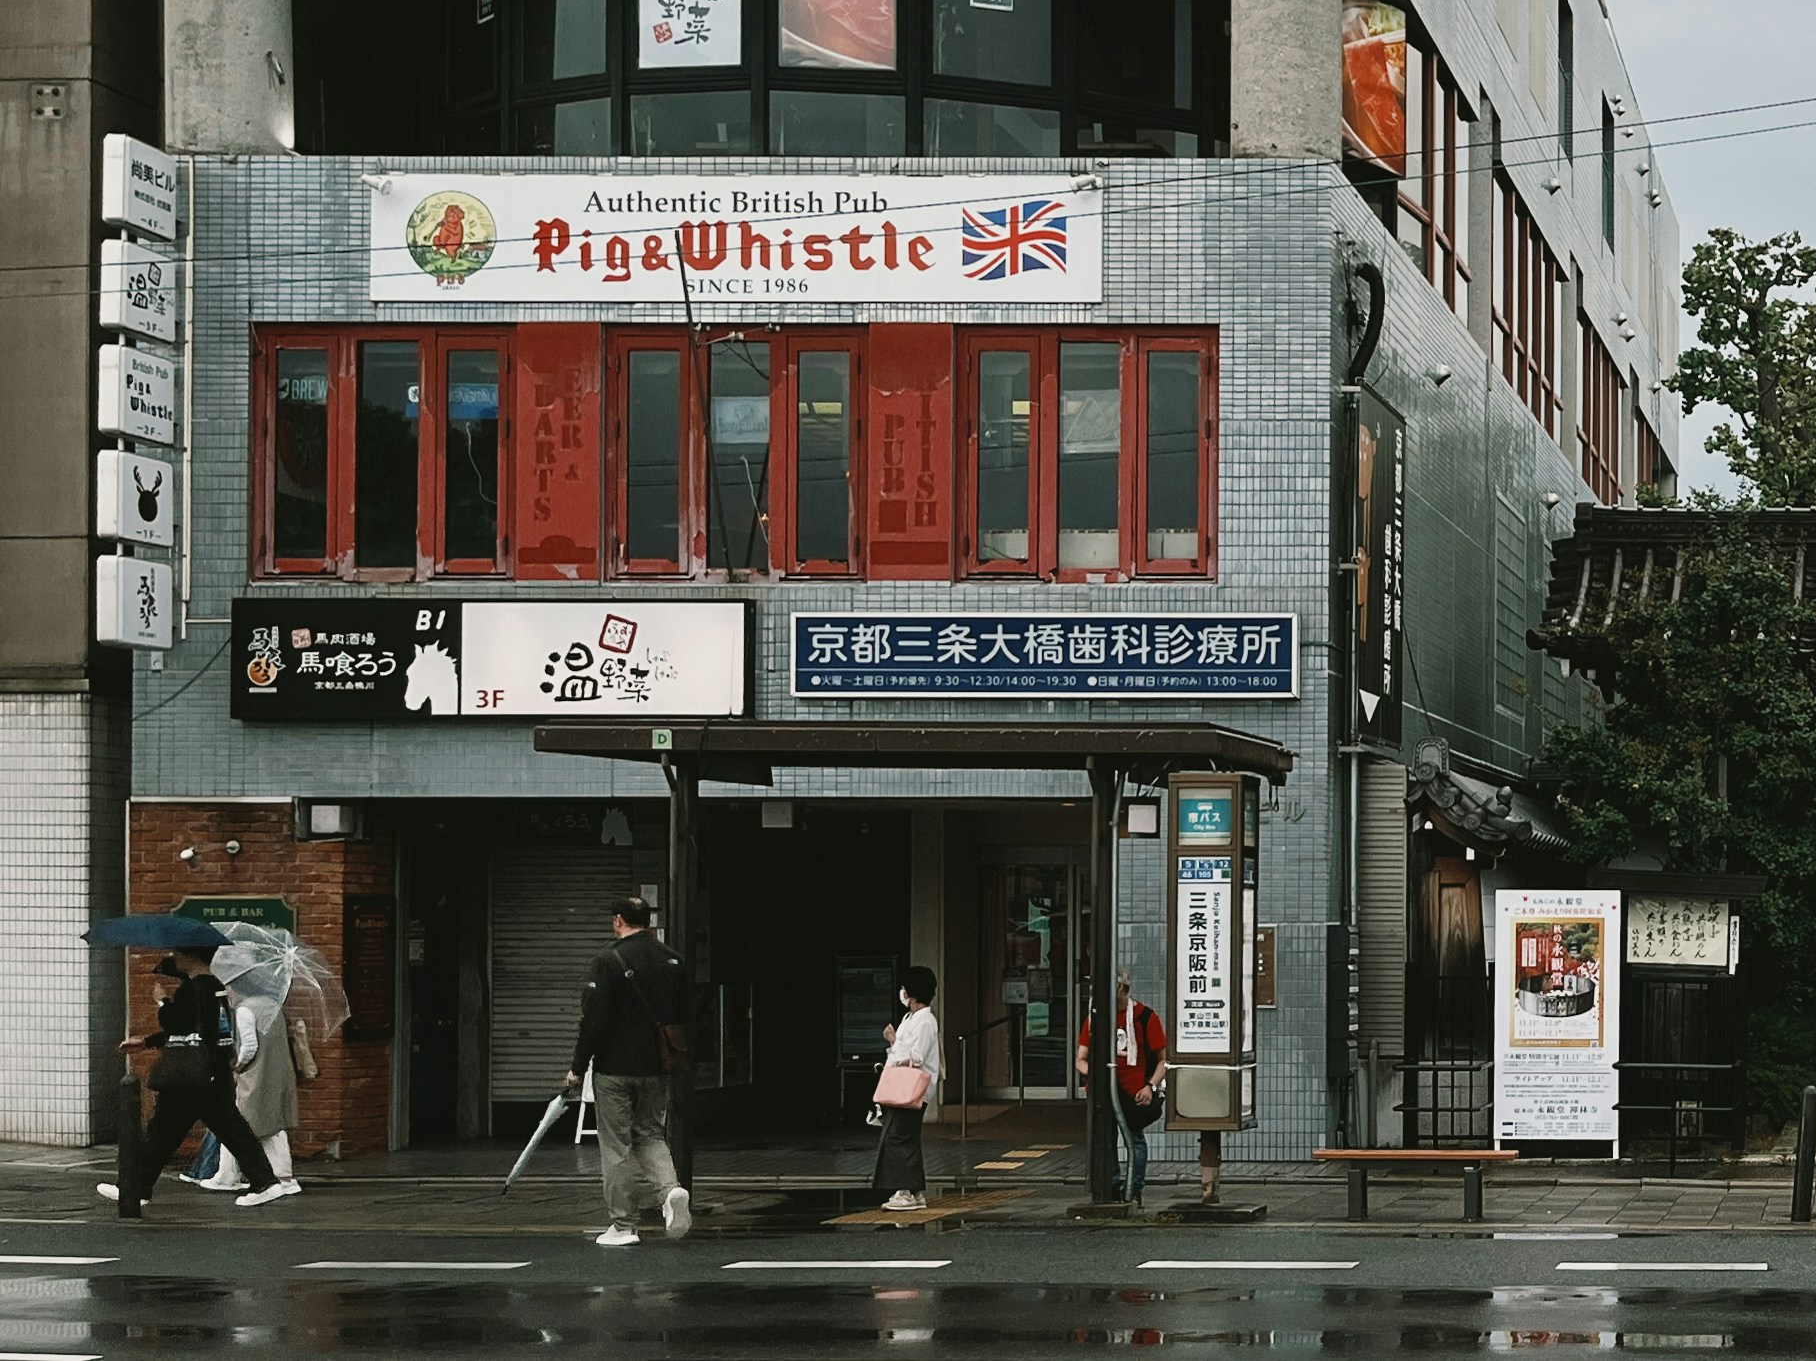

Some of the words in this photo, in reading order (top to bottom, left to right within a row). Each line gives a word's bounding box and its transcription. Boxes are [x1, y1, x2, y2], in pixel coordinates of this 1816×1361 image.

[131, 158, 175, 193] 尚美ビル
[584, 190, 721, 213] Authentic
[732, 190, 823, 214] British
[834, 190, 888, 214] Pub
[533, 217, 936, 282] Pig&Whistle
[686, 278, 753, 294] SINCE
[764, 278, 809, 294] 1986
[132, 358, 153, 376] British
[155, 364, 169, 380] Pub
[130, 396, 173, 422] Whistle
[415, 609, 446, 631] B1
[314, 632, 376, 646] 馬肉酒場
[807, 623, 1281, 665] 京都三条大橋歯科診療所
[297, 650, 397, 676] 馬喰ろう
[540, 642, 651, 703] 温野菜
[475, 690, 506, 708] 3F
[658, 733, 668, 744] D
[1188, 812, 1221, 823] 市バス
[1219, 860, 1229, 868] 12
[203, 907, 226, 917] PUB
[229, 907, 237, 917] &
[241, 907, 264, 917] BAR
[1188, 892, 1207, 994] 三条京阪前
